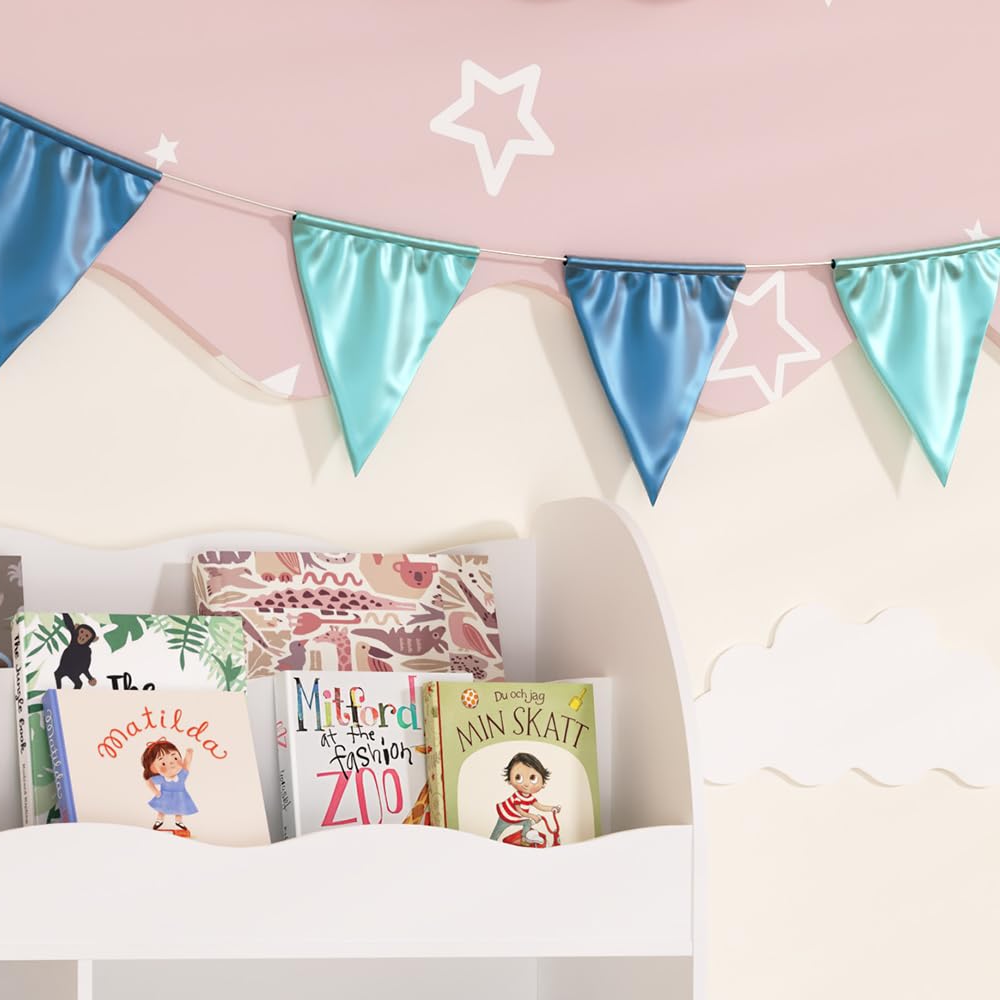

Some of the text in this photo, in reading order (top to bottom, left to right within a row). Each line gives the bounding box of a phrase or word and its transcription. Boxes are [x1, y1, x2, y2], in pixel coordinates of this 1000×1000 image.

[293, 675, 422, 732] Mitford
[494, 689, 545, 705] Du och jag
[97, 706, 228, 759] Matilda
[320, 726, 375, 748] at the
[456, 707, 590, 752] MIN SKATT
[45, 708, 63, 799] Matilda
[329, 737, 413, 780] fashion
